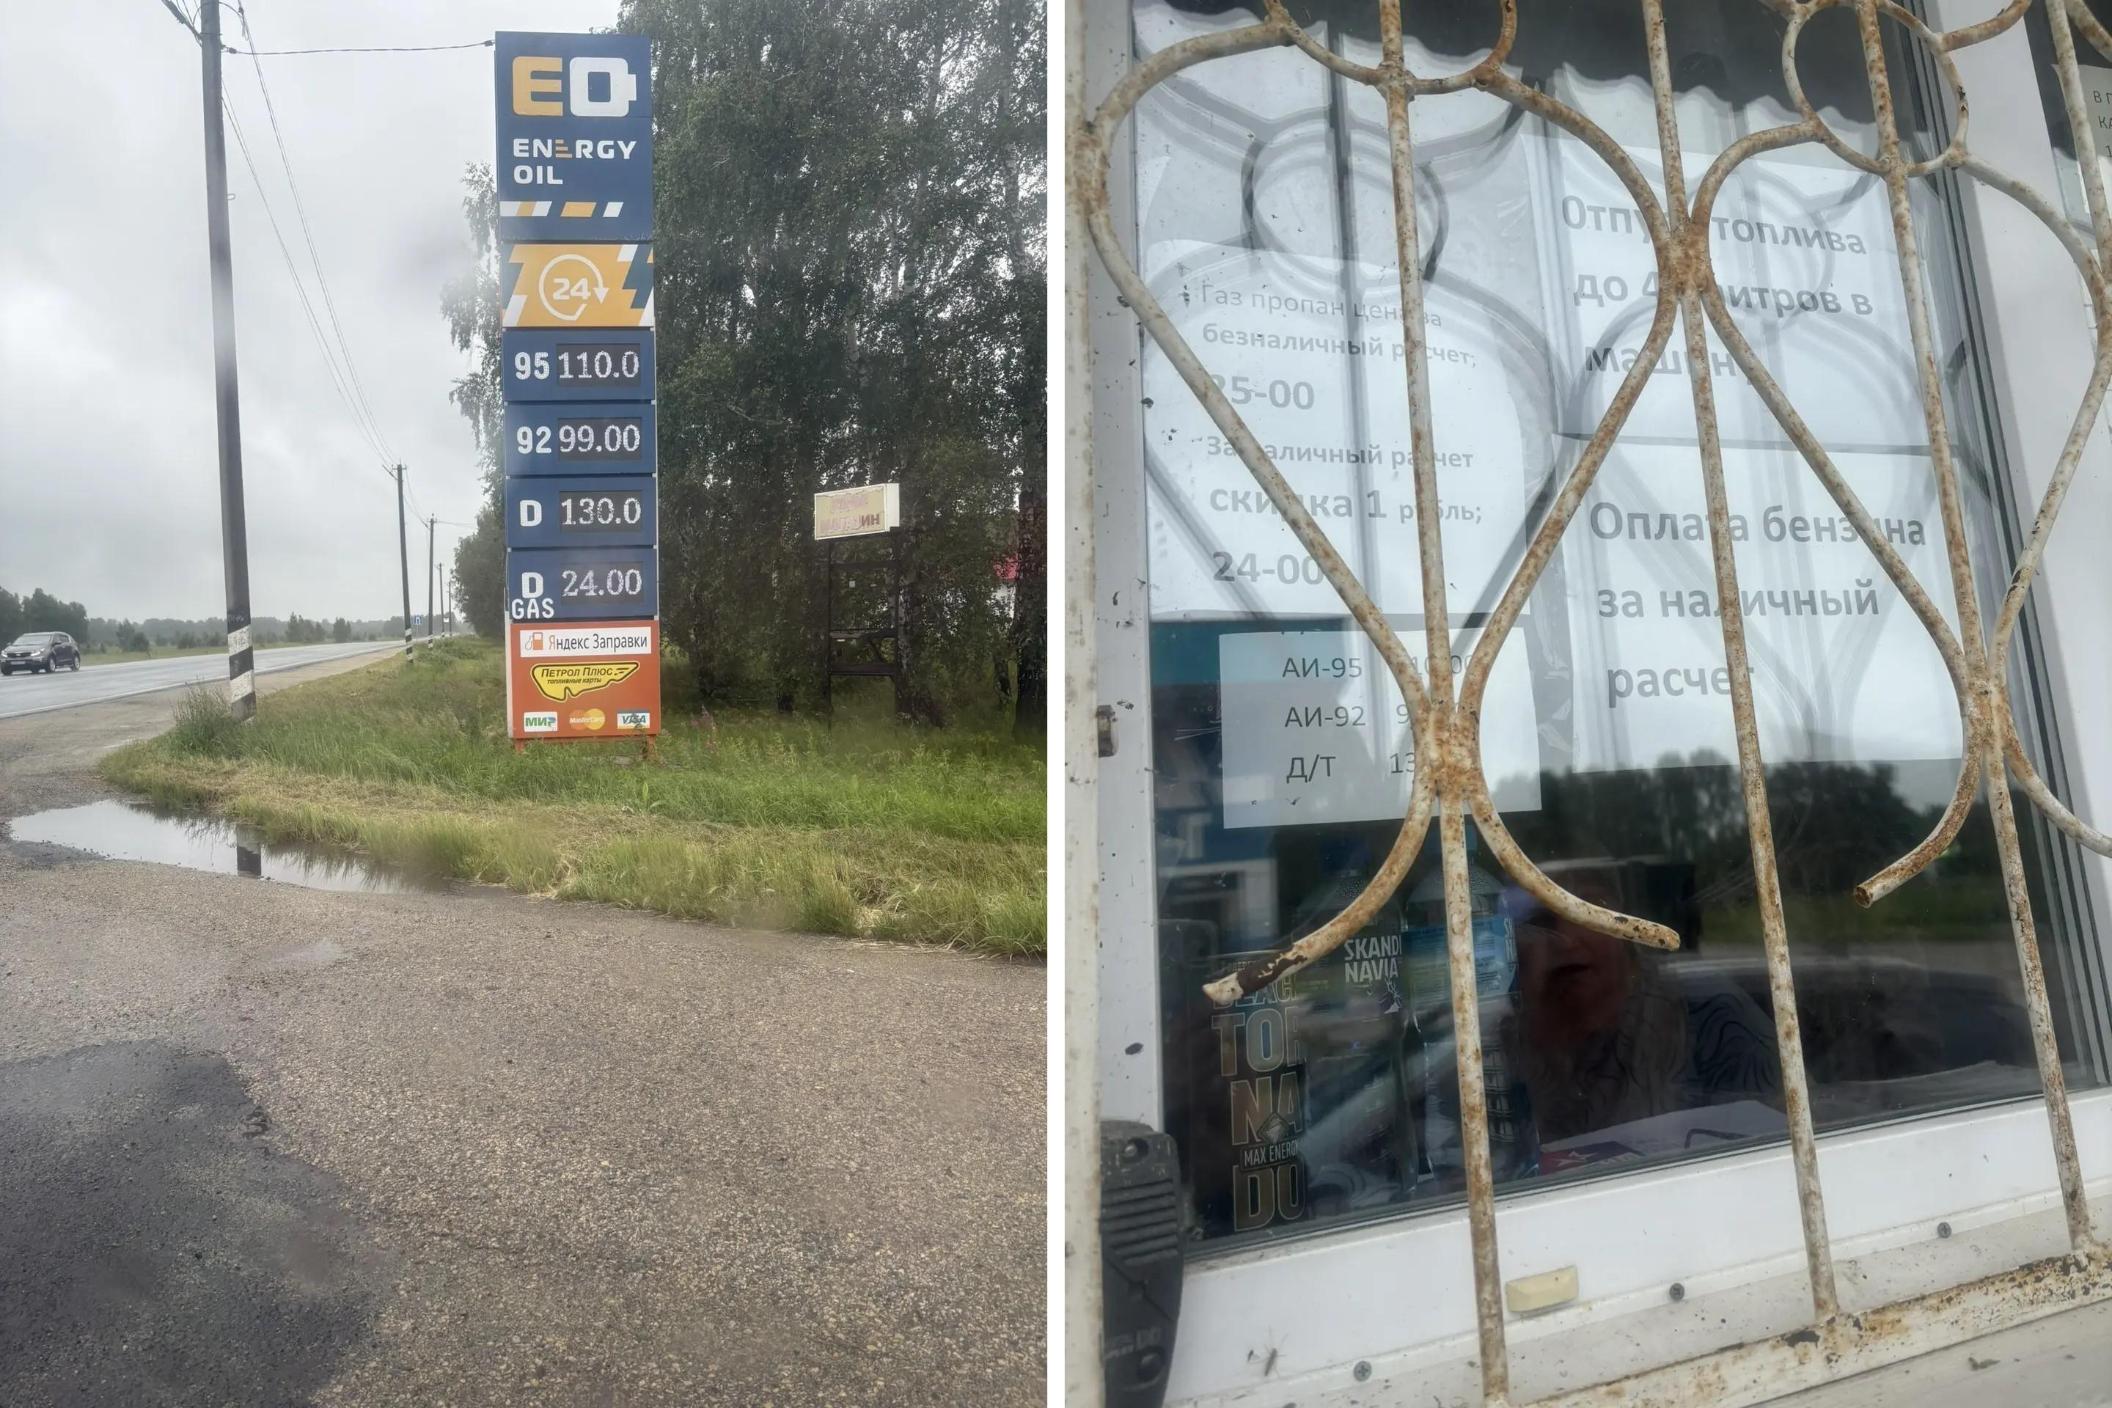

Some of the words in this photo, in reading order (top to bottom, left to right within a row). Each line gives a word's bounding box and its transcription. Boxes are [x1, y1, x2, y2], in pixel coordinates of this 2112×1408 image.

[513, 138, 637, 159] ENERGY
[513, 165, 563, 184] OIL
[1711, 217, 1867, 254] топлива
[553, 277, 592, 301] 24
[1202, 285, 1243, 306] Газ
[1252, 294, 1345, 317] пропан
[1573, 274, 1629, 307] до
[1716, 284, 1842, 318] итров
[1851, 294, 1873, 316] в
[1203, 323, 1384, 357] безналичный
[515, 352, 550, 380] 95
[558, 351, 640, 379] 110.0
[516, 426, 552, 454] 92
[558, 424, 641, 452] 99.00
[1263, 437, 1383, 465] аличный
[519, 500, 542, 527] D
[561, 497, 641, 525] 130.0
[1209, 488, 1353, 521] скика
[1367, 489, 1387, 519] 1
[1590, 501, 1749, 542] Оплаа
[1763, 505, 1927, 546] бензна
[521, 572, 544, 599] D
[561, 569, 642, 597] 24.00
[1598, 588, 1645, 618] за
[1661, 577, 1880, 618] наичный
[511, 598, 555, 620] GAS
[549, 634, 589, 651] Яндекс
[592, 633, 648, 653] Заправки
[1282, 657, 1362, 679] АИ-95
[1607, 665, 1755, 708] расче
[1285, 706, 1366, 728] АИ-92
[1286, 755, 1337, 783] Д/Т
[1244, 1149, 1267, 1167] MAX
